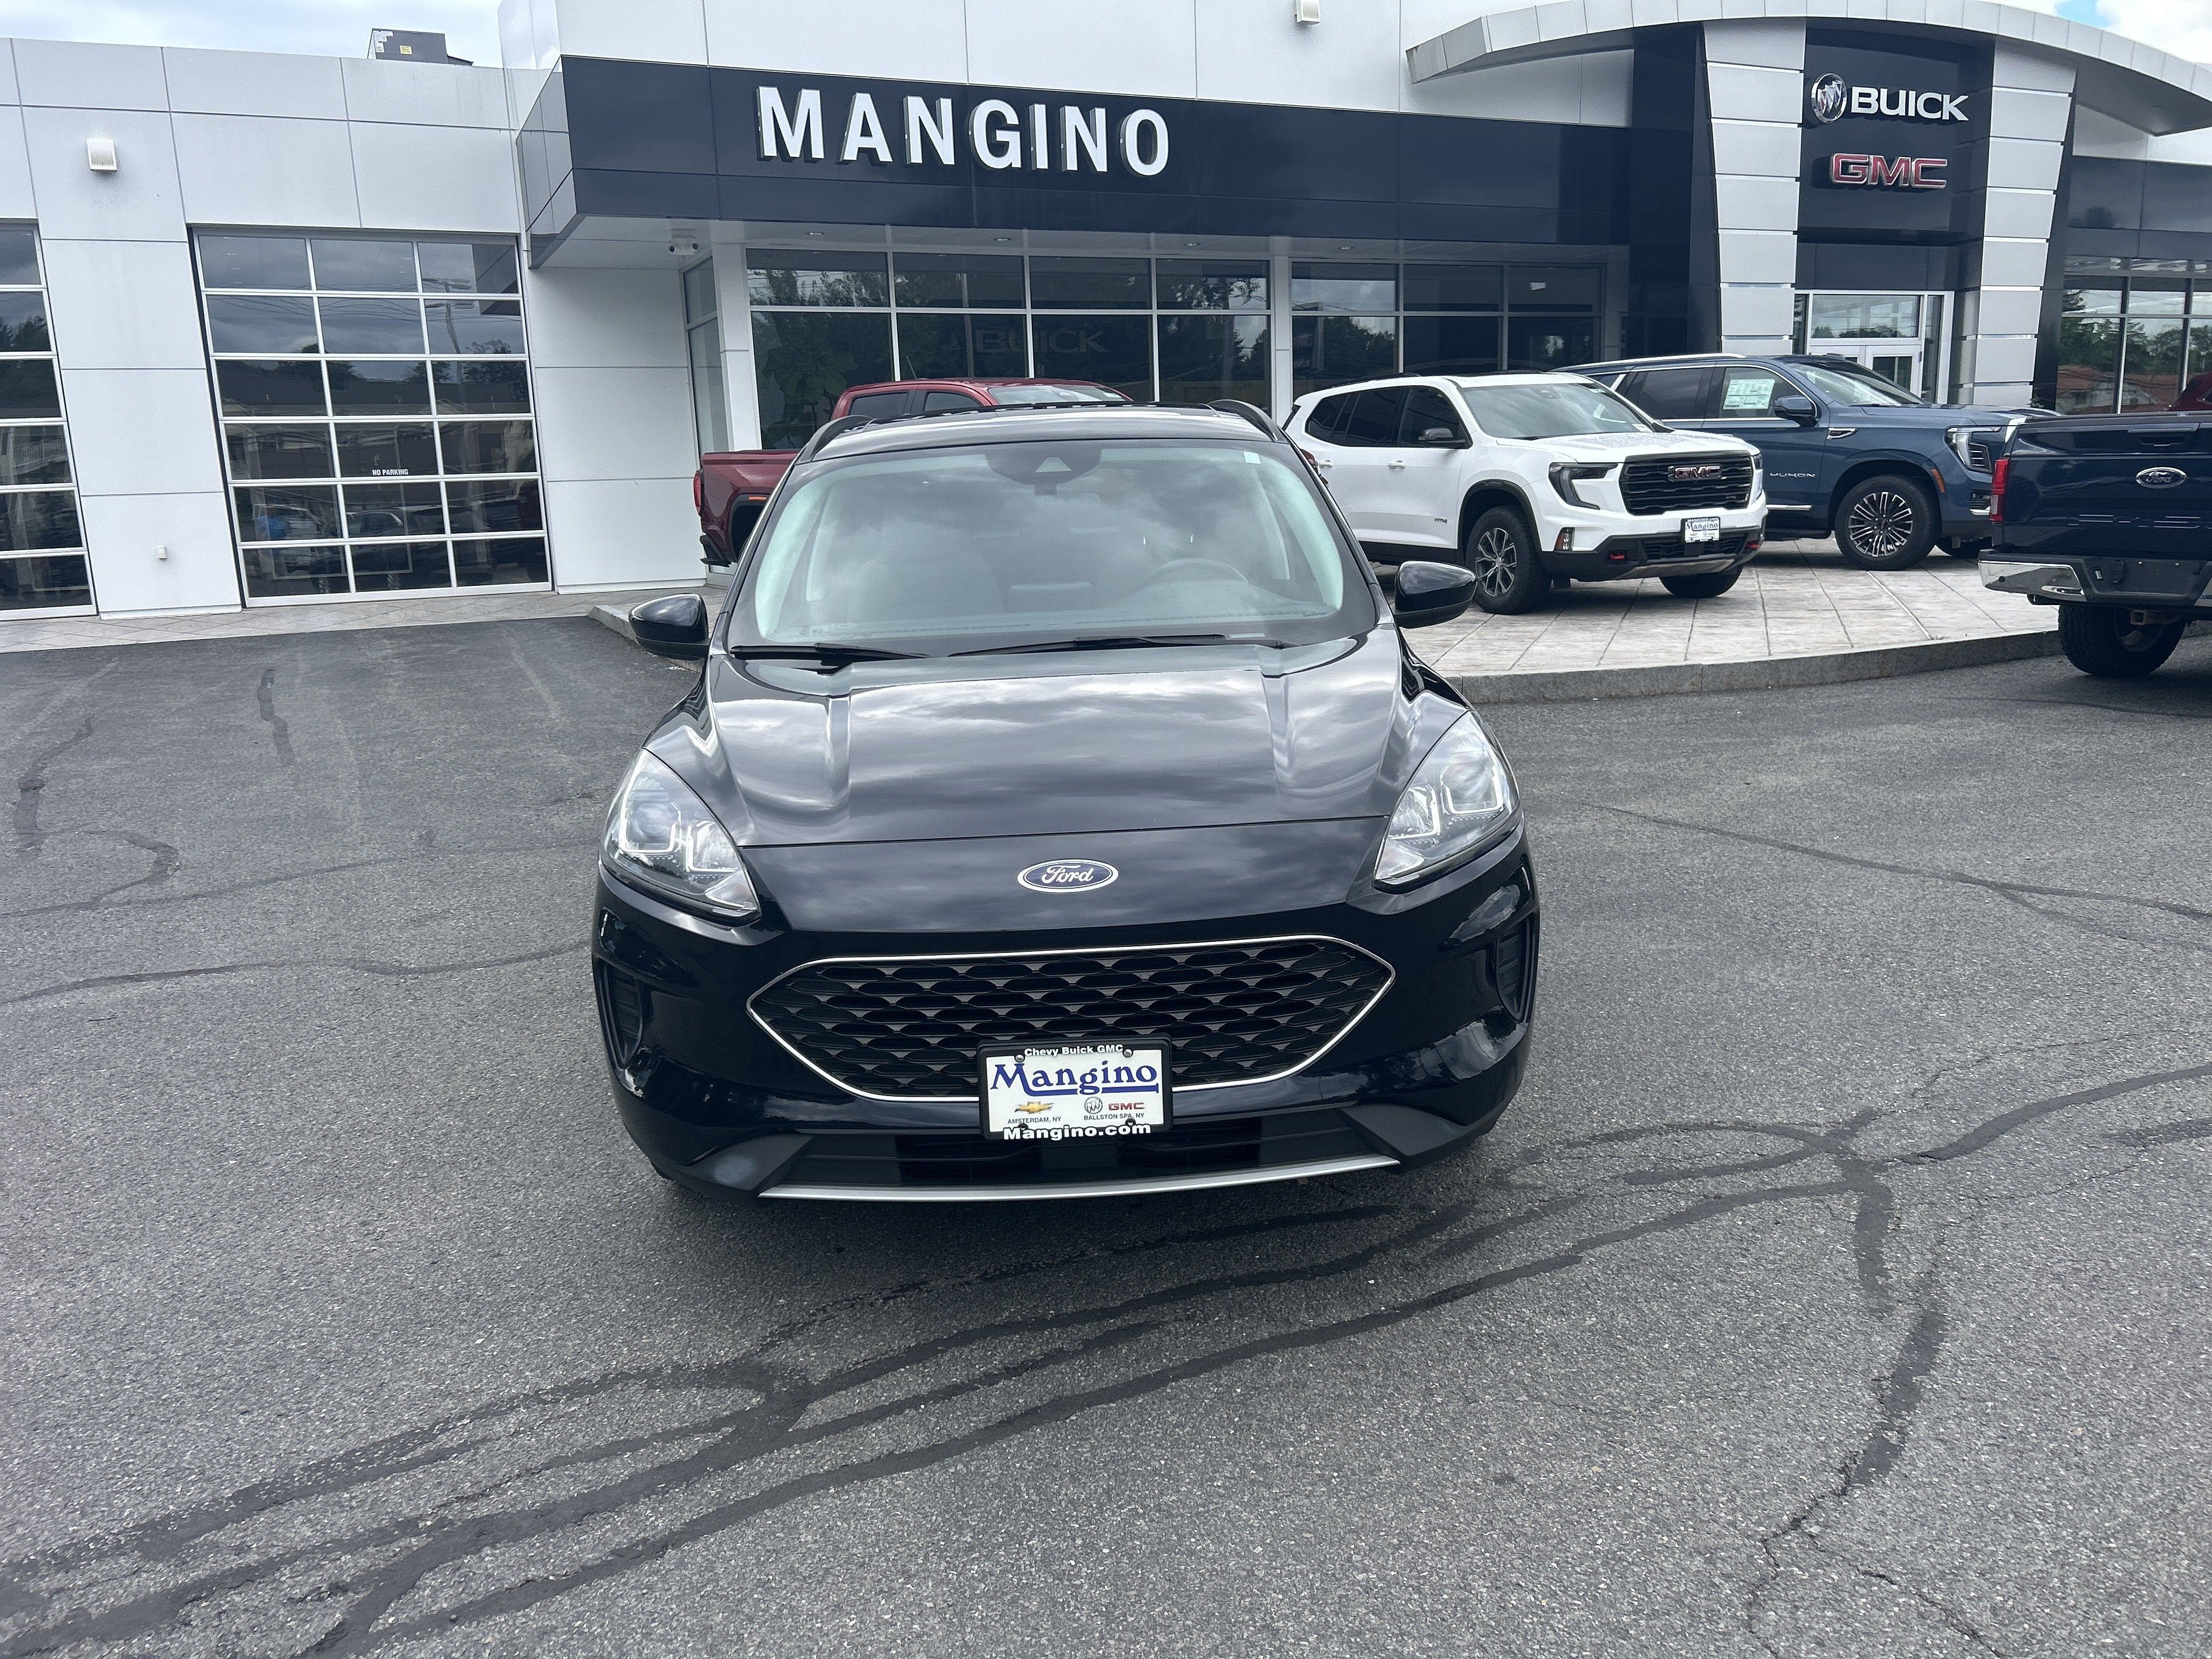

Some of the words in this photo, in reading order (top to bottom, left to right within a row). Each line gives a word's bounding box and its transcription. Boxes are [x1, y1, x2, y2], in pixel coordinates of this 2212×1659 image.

[1851, 86, 1969, 121] BUICK
[757, 85, 1169, 177] MANGINO
[1832, 153, 1948, 189] GMC
[975, 330, 1109, 353] BUICK
[1675, 466, 1720, 479] GMC
[2146, 471, 2174, 483] Ford
[1685, 521, 1718, 532] Mangino
[1041, 865, 1094, 884] Ford
[1024, 1048, 1059, 1057] Chevy
[1062, 1046, 1094, 1054] Buick
[1097, 1044, 1124, 1053] GMC
[990, 1060, 1159, 1096] Mangino
[1108, 1102, 1144, 1110] GMC
[1003, 1124, 1151, 1141] Mangino.com
